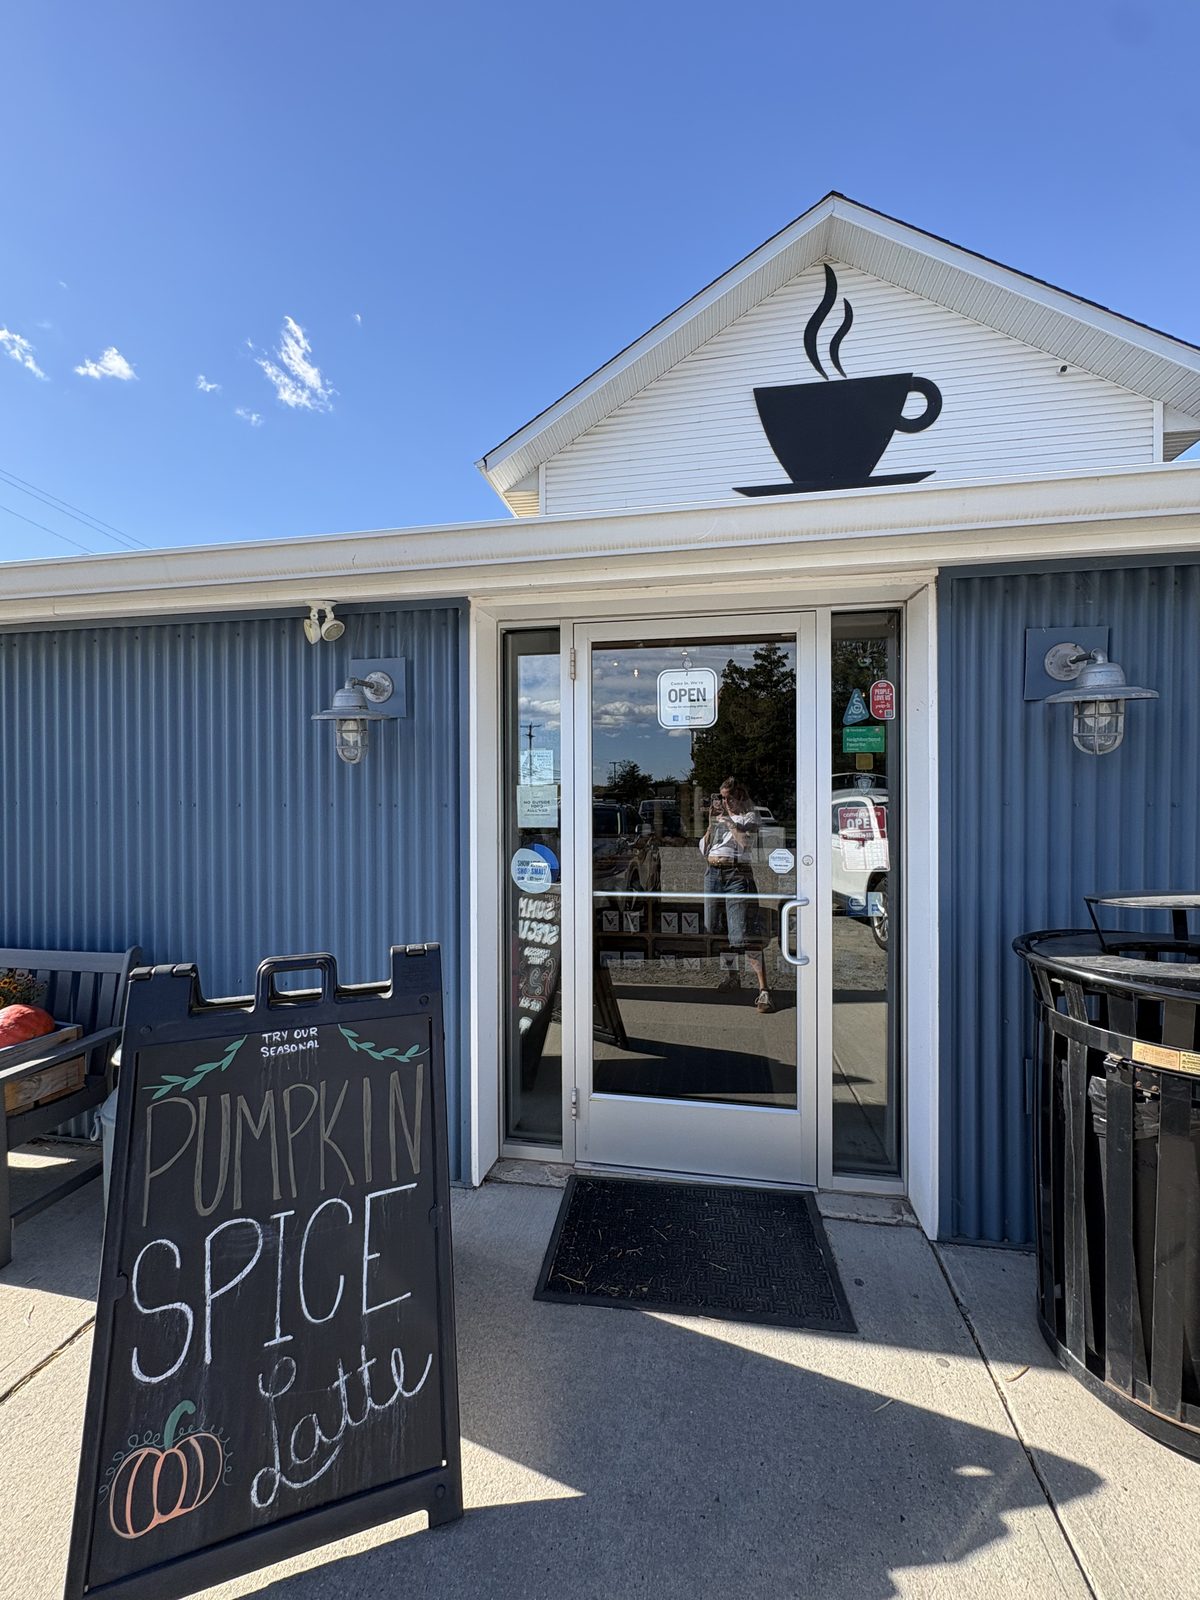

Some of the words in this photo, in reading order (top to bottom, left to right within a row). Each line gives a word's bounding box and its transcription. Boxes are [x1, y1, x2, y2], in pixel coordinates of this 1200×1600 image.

[668, 687, 706, 703] OPEN
[262, 1031, 288, 1044] TRY
[293, 1027, 318, 1039] OUR
[260, 1040, 320, 1058] SEASONAL
[142, 1063, 425, 1228] PUMPKIN
[131, 1183, 418, 1385] SPICE
